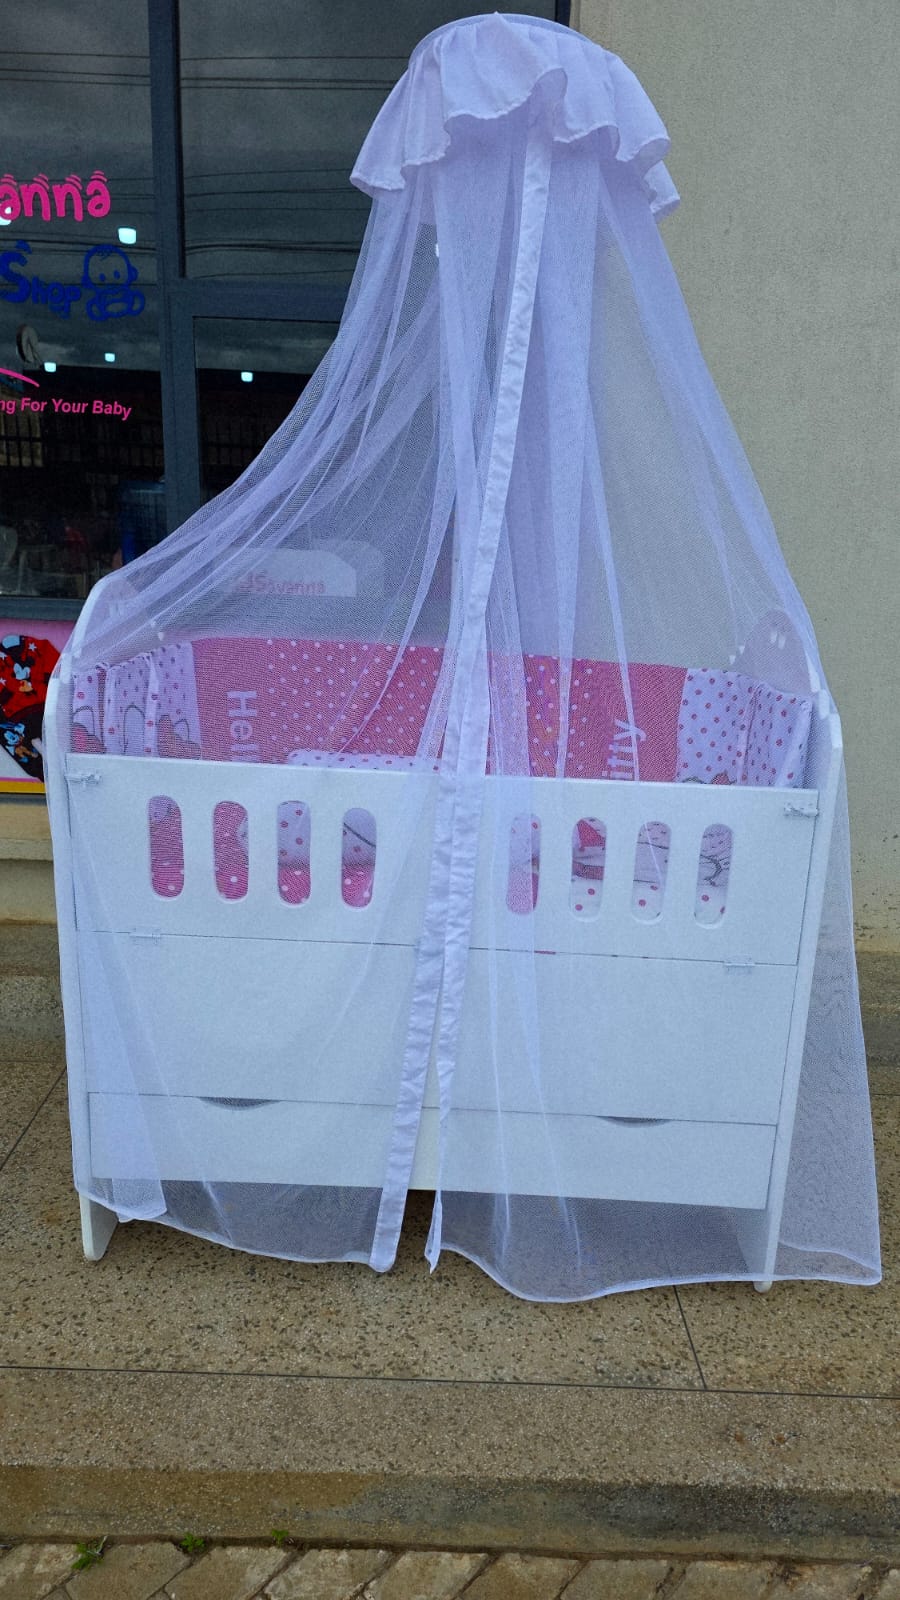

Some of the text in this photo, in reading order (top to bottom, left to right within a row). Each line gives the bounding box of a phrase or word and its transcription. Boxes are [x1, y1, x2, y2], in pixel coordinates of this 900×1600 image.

[21, 397, 47, 412] For
[52, 398, 88, 414] Your
[92, 400, 132, 421] Baby
